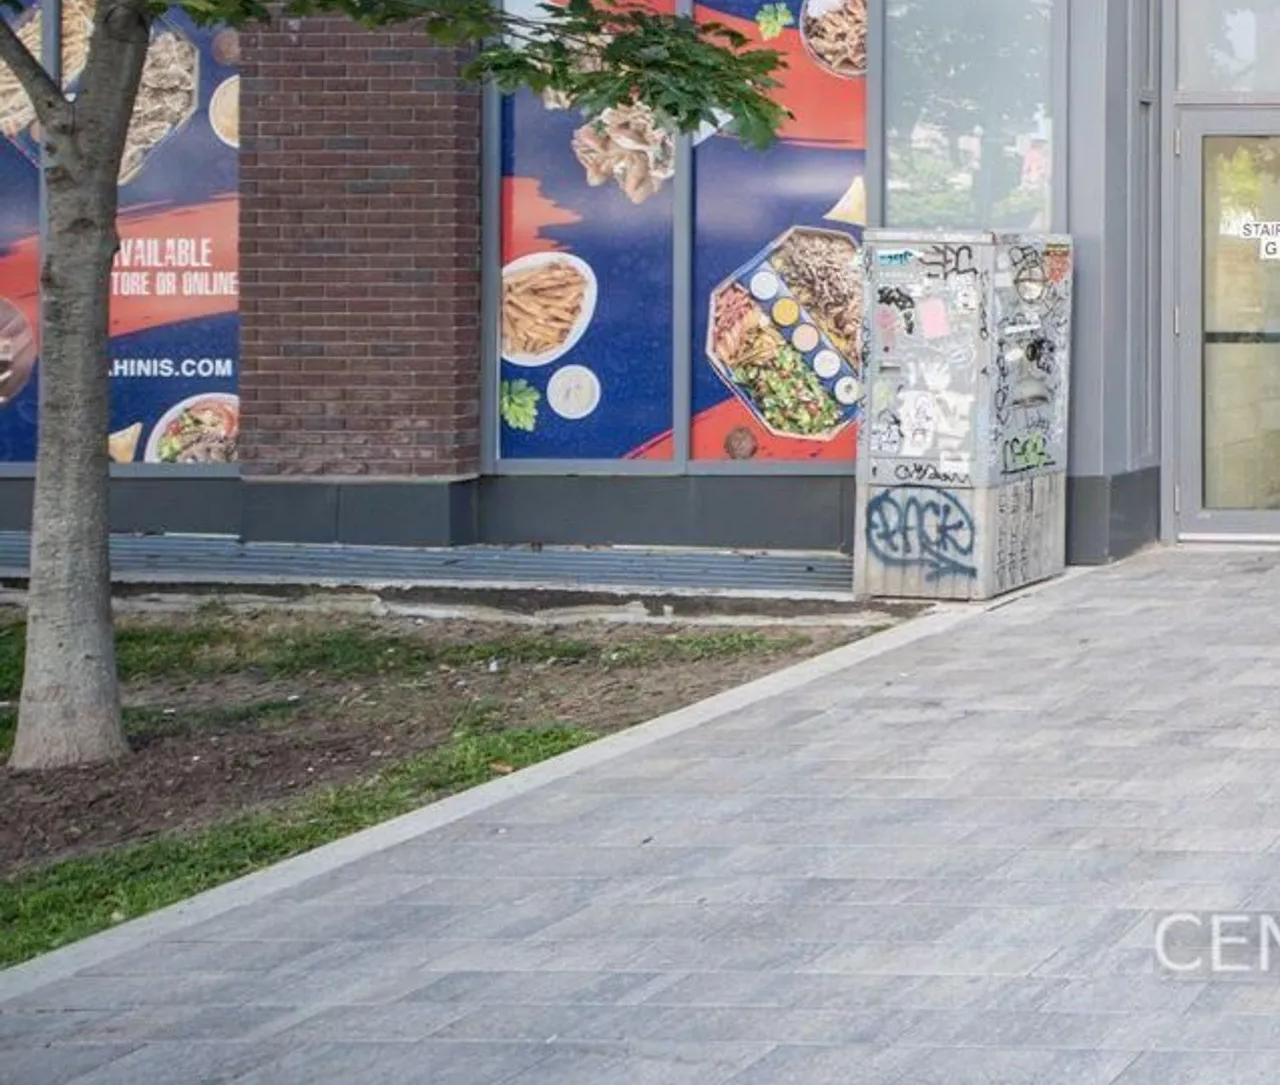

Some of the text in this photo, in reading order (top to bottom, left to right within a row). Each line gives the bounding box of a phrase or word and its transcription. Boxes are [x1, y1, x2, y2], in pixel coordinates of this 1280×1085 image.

[1265, 242, 1277, 255] G
[157, 271, 176, 296] OR
[183, 271, 239, 296] ONLINE
[108, 358, 233, 377] HINIS.COM
